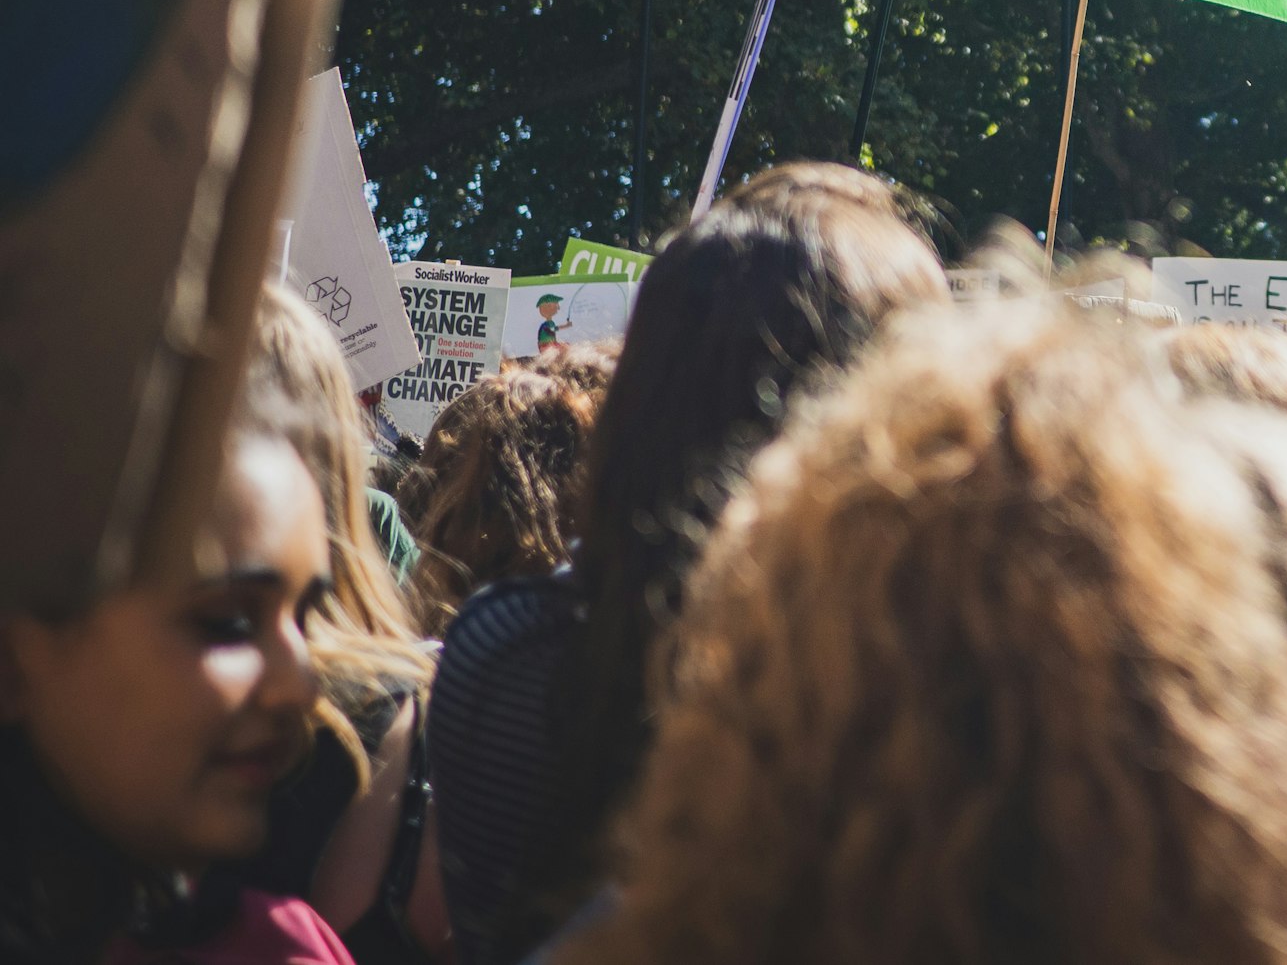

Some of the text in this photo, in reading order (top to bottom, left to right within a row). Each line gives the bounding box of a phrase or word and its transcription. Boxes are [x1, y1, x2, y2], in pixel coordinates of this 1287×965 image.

[415, 268, 490, 285] Socialist Worker
[400, 286, 486, 314] SYSTEM
[406, 309, 488, 338] HANGE
[437, 348, 474, 358] revolution
[438, 337, 486, 350] One solution:
[387, 377, 474, 403] CHANG
